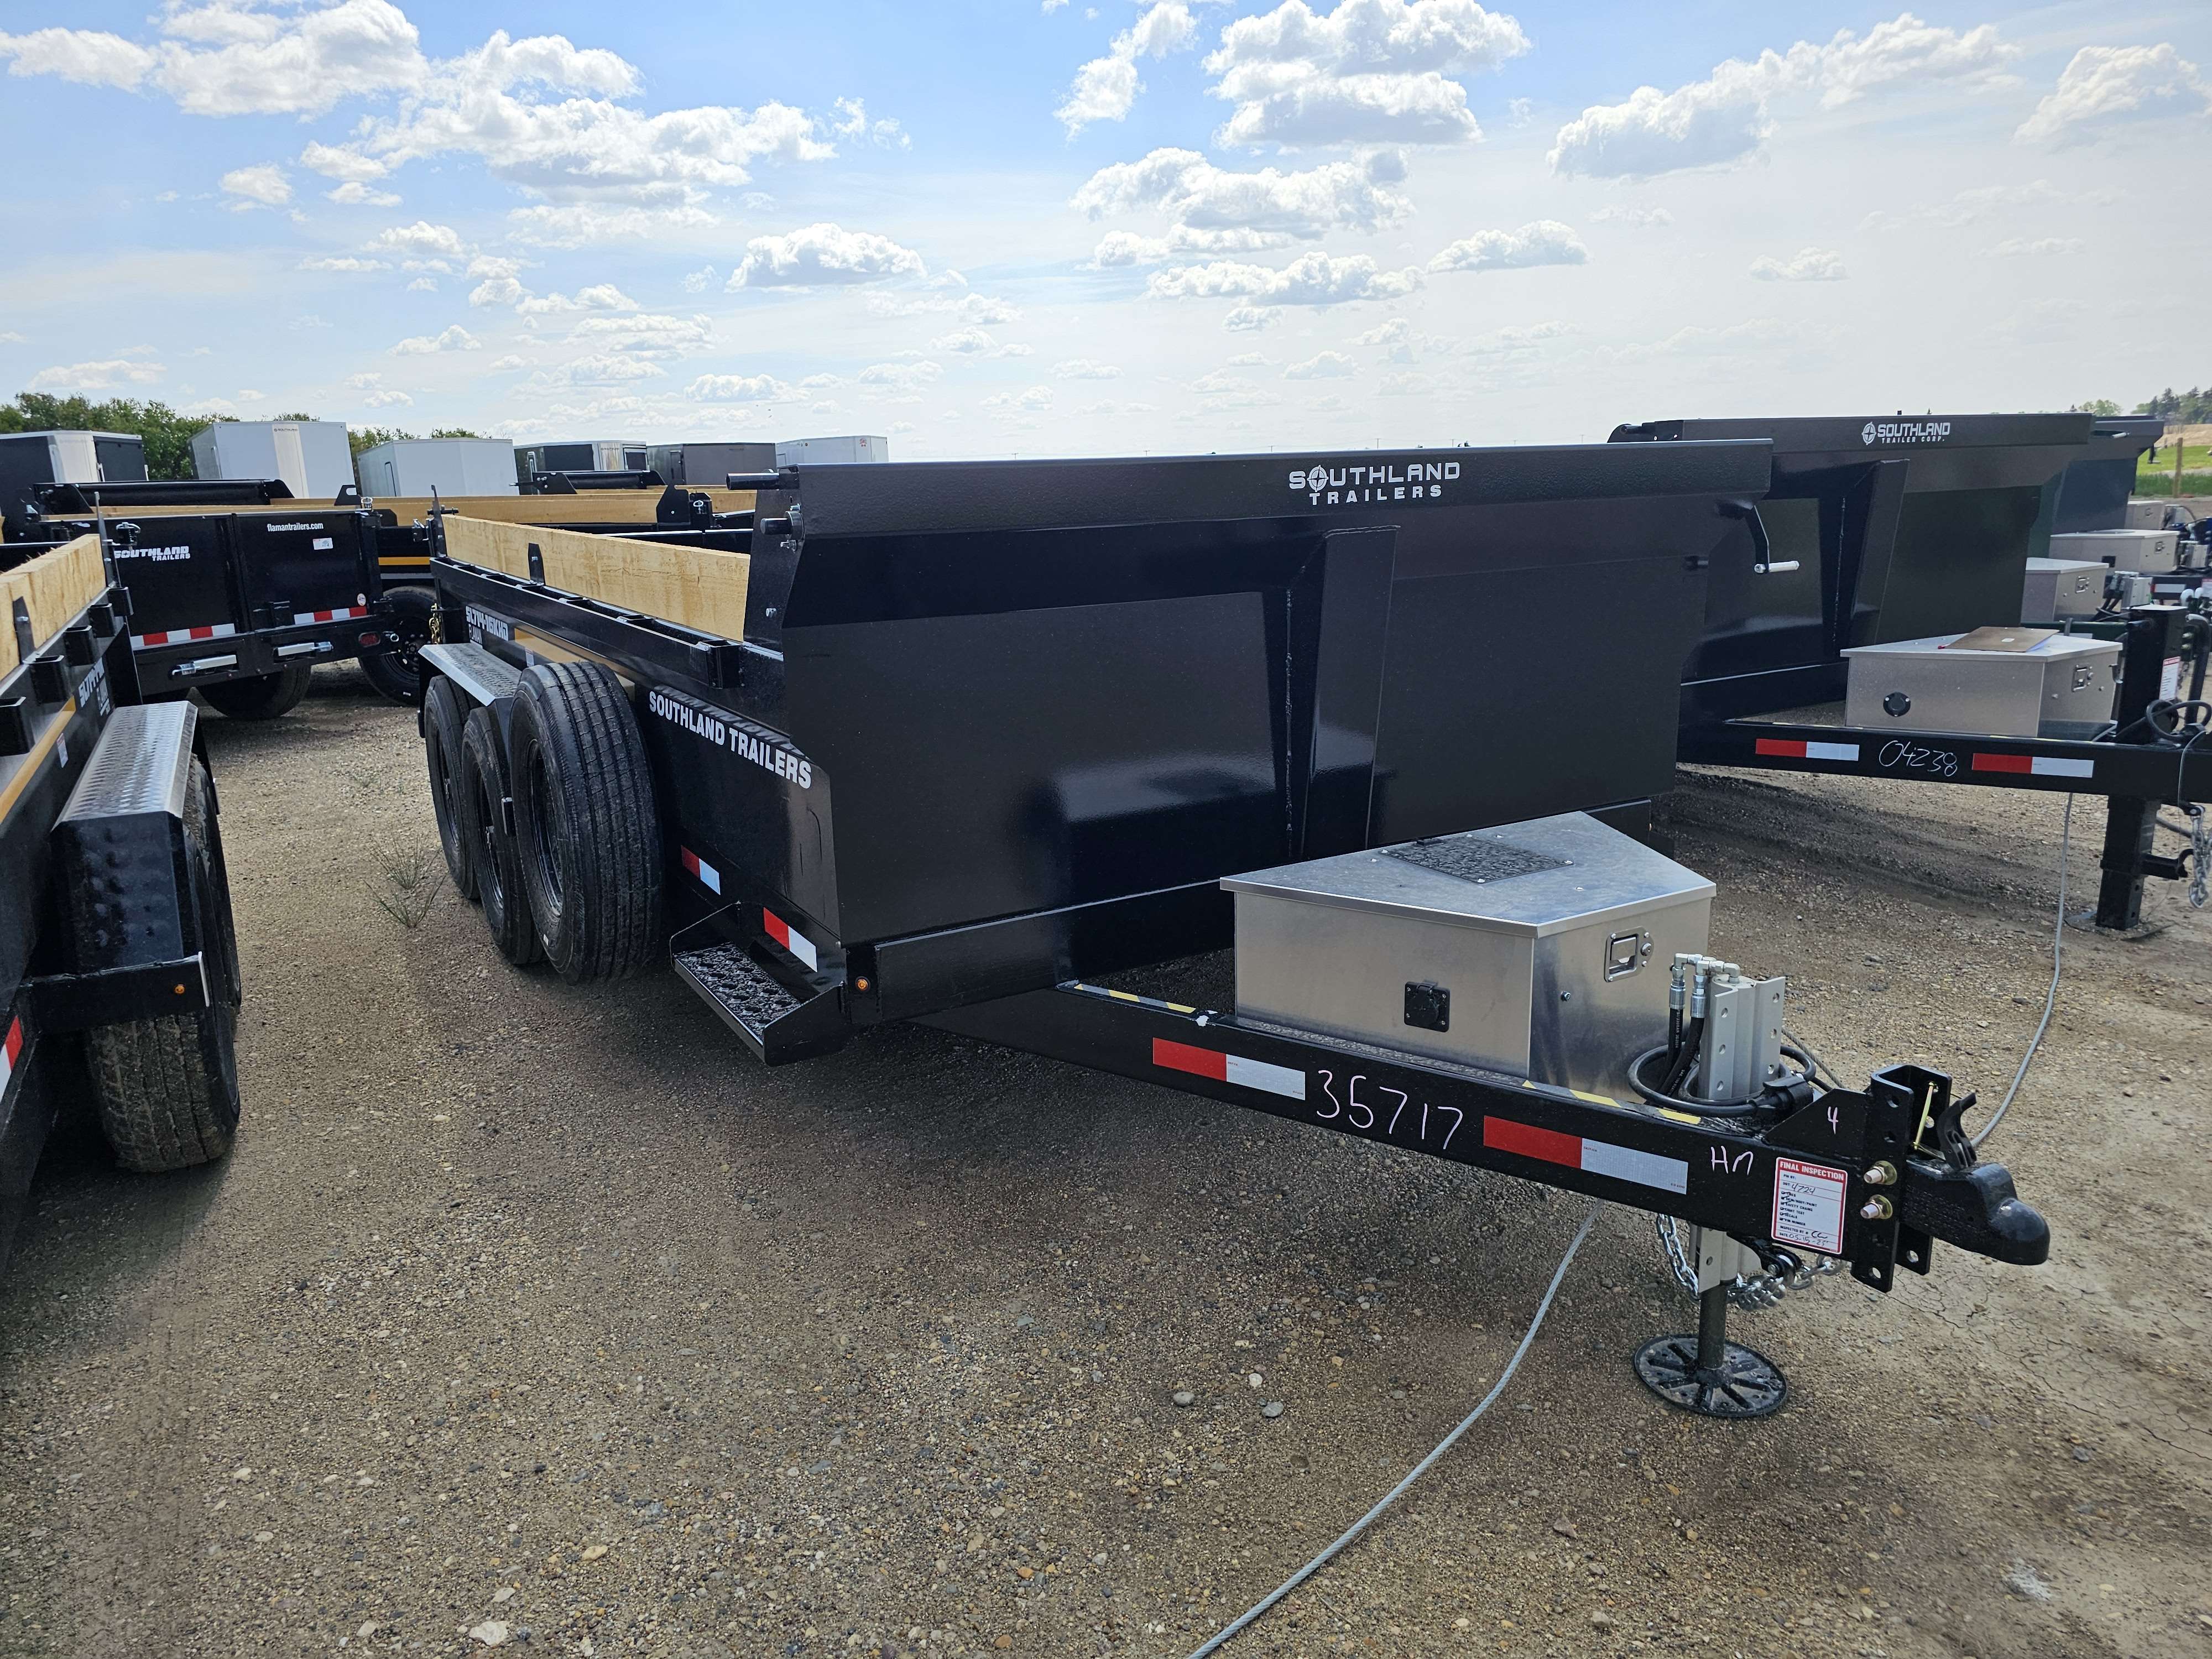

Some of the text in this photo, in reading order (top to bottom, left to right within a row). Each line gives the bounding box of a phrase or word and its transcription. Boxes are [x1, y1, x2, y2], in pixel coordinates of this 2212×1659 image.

[1877, 422, 1950, 437] SOUTHLAND
[1289, 462, 1460, 492] SOUTHLAND
[1309, 484, 1442, 505] TRAILERS
[267, 523, 324, 531] flamantrailers.com
[114, 546, 189, 559] SOUTHLAND
[152, 553, 191, 561] TRAILERS
[649, 691, 812, 790] SOUTHLAND TRAILERS
[1879, 740, 1958, 777] 04238
[1317, 1070, 1463, 1150] 35717
[1827, 1106, 1839, 1135] 4
[1780, 1161, 1844, 1181] FINAL INSPECTION
